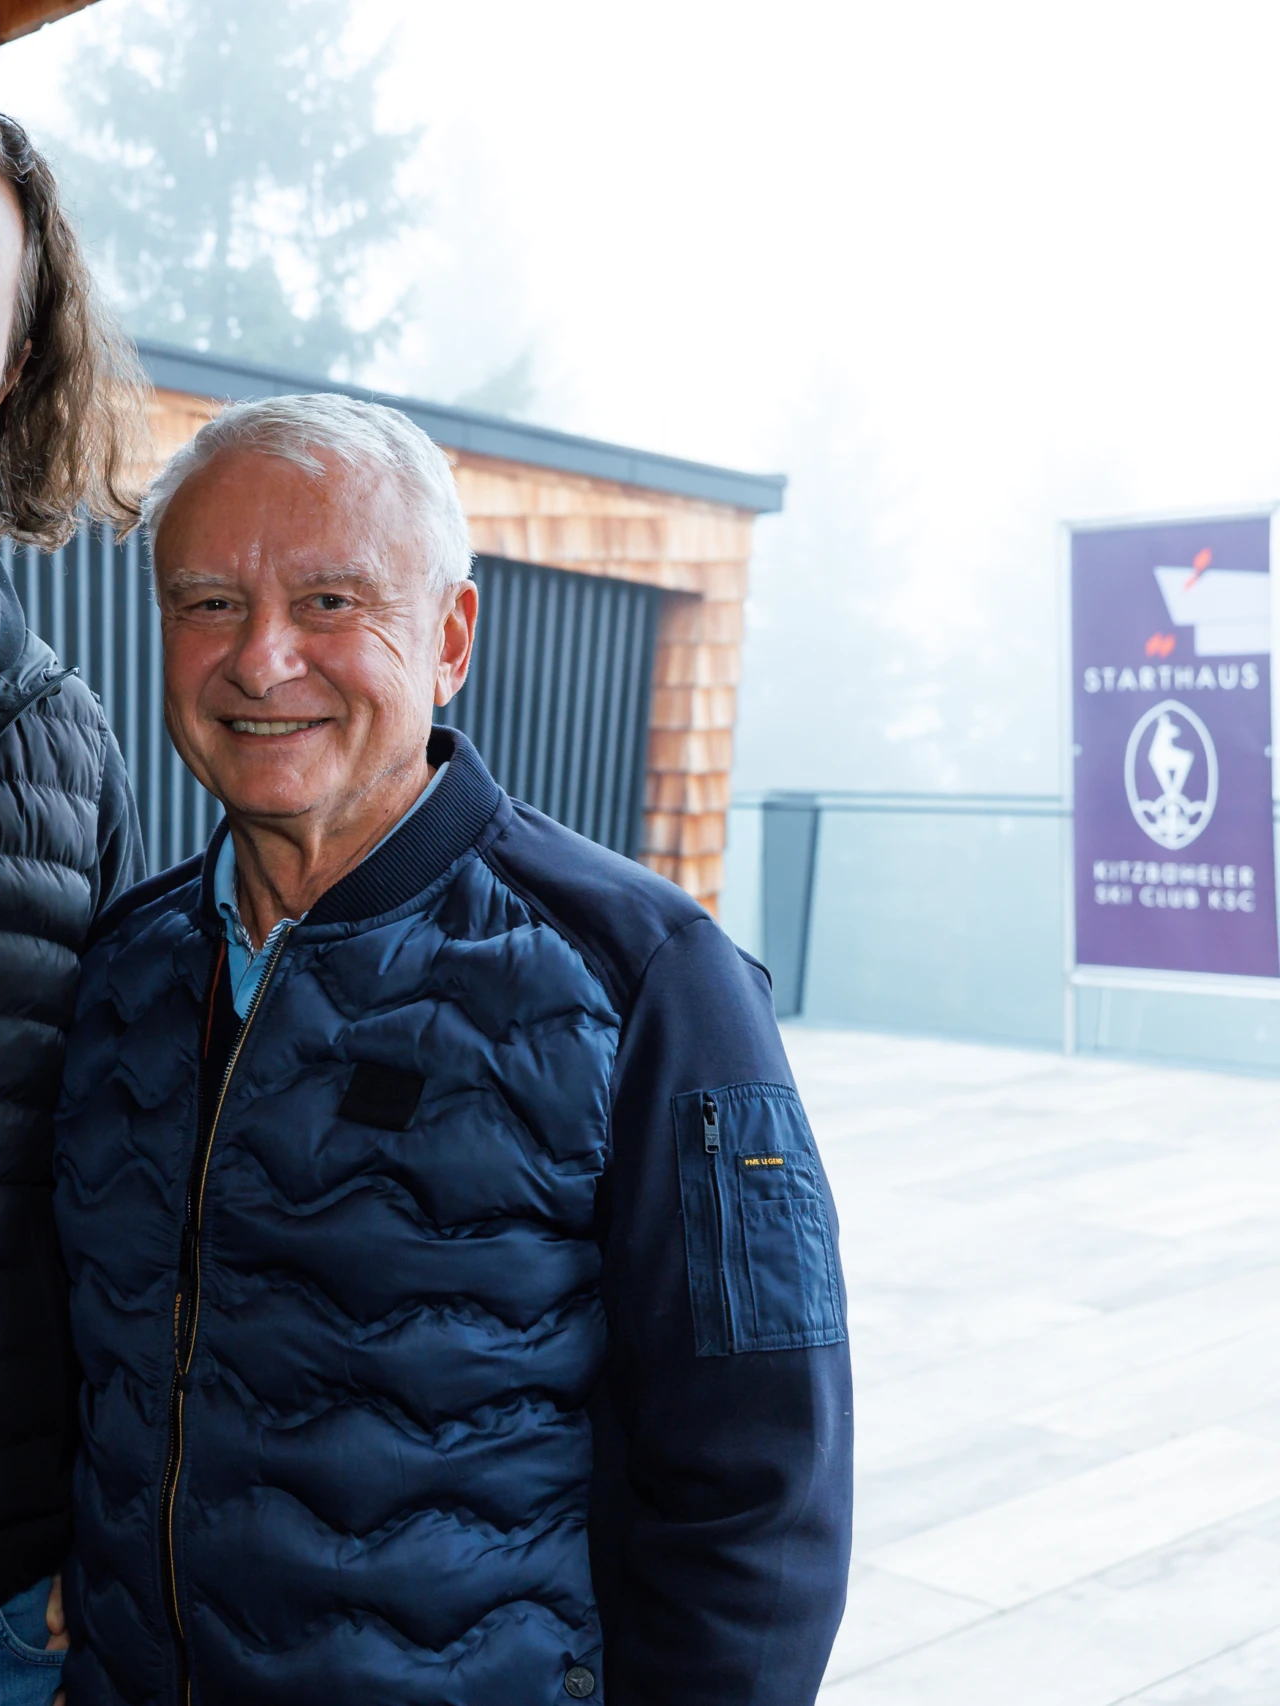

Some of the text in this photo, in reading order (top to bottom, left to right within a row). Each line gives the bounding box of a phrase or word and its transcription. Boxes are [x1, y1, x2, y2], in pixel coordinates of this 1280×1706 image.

[1083, 662, 1260, 693] STARTHAUS
[1139, 885, 1200, 910] CLUB
[761, 1157, 784, 1165] LEGEND
